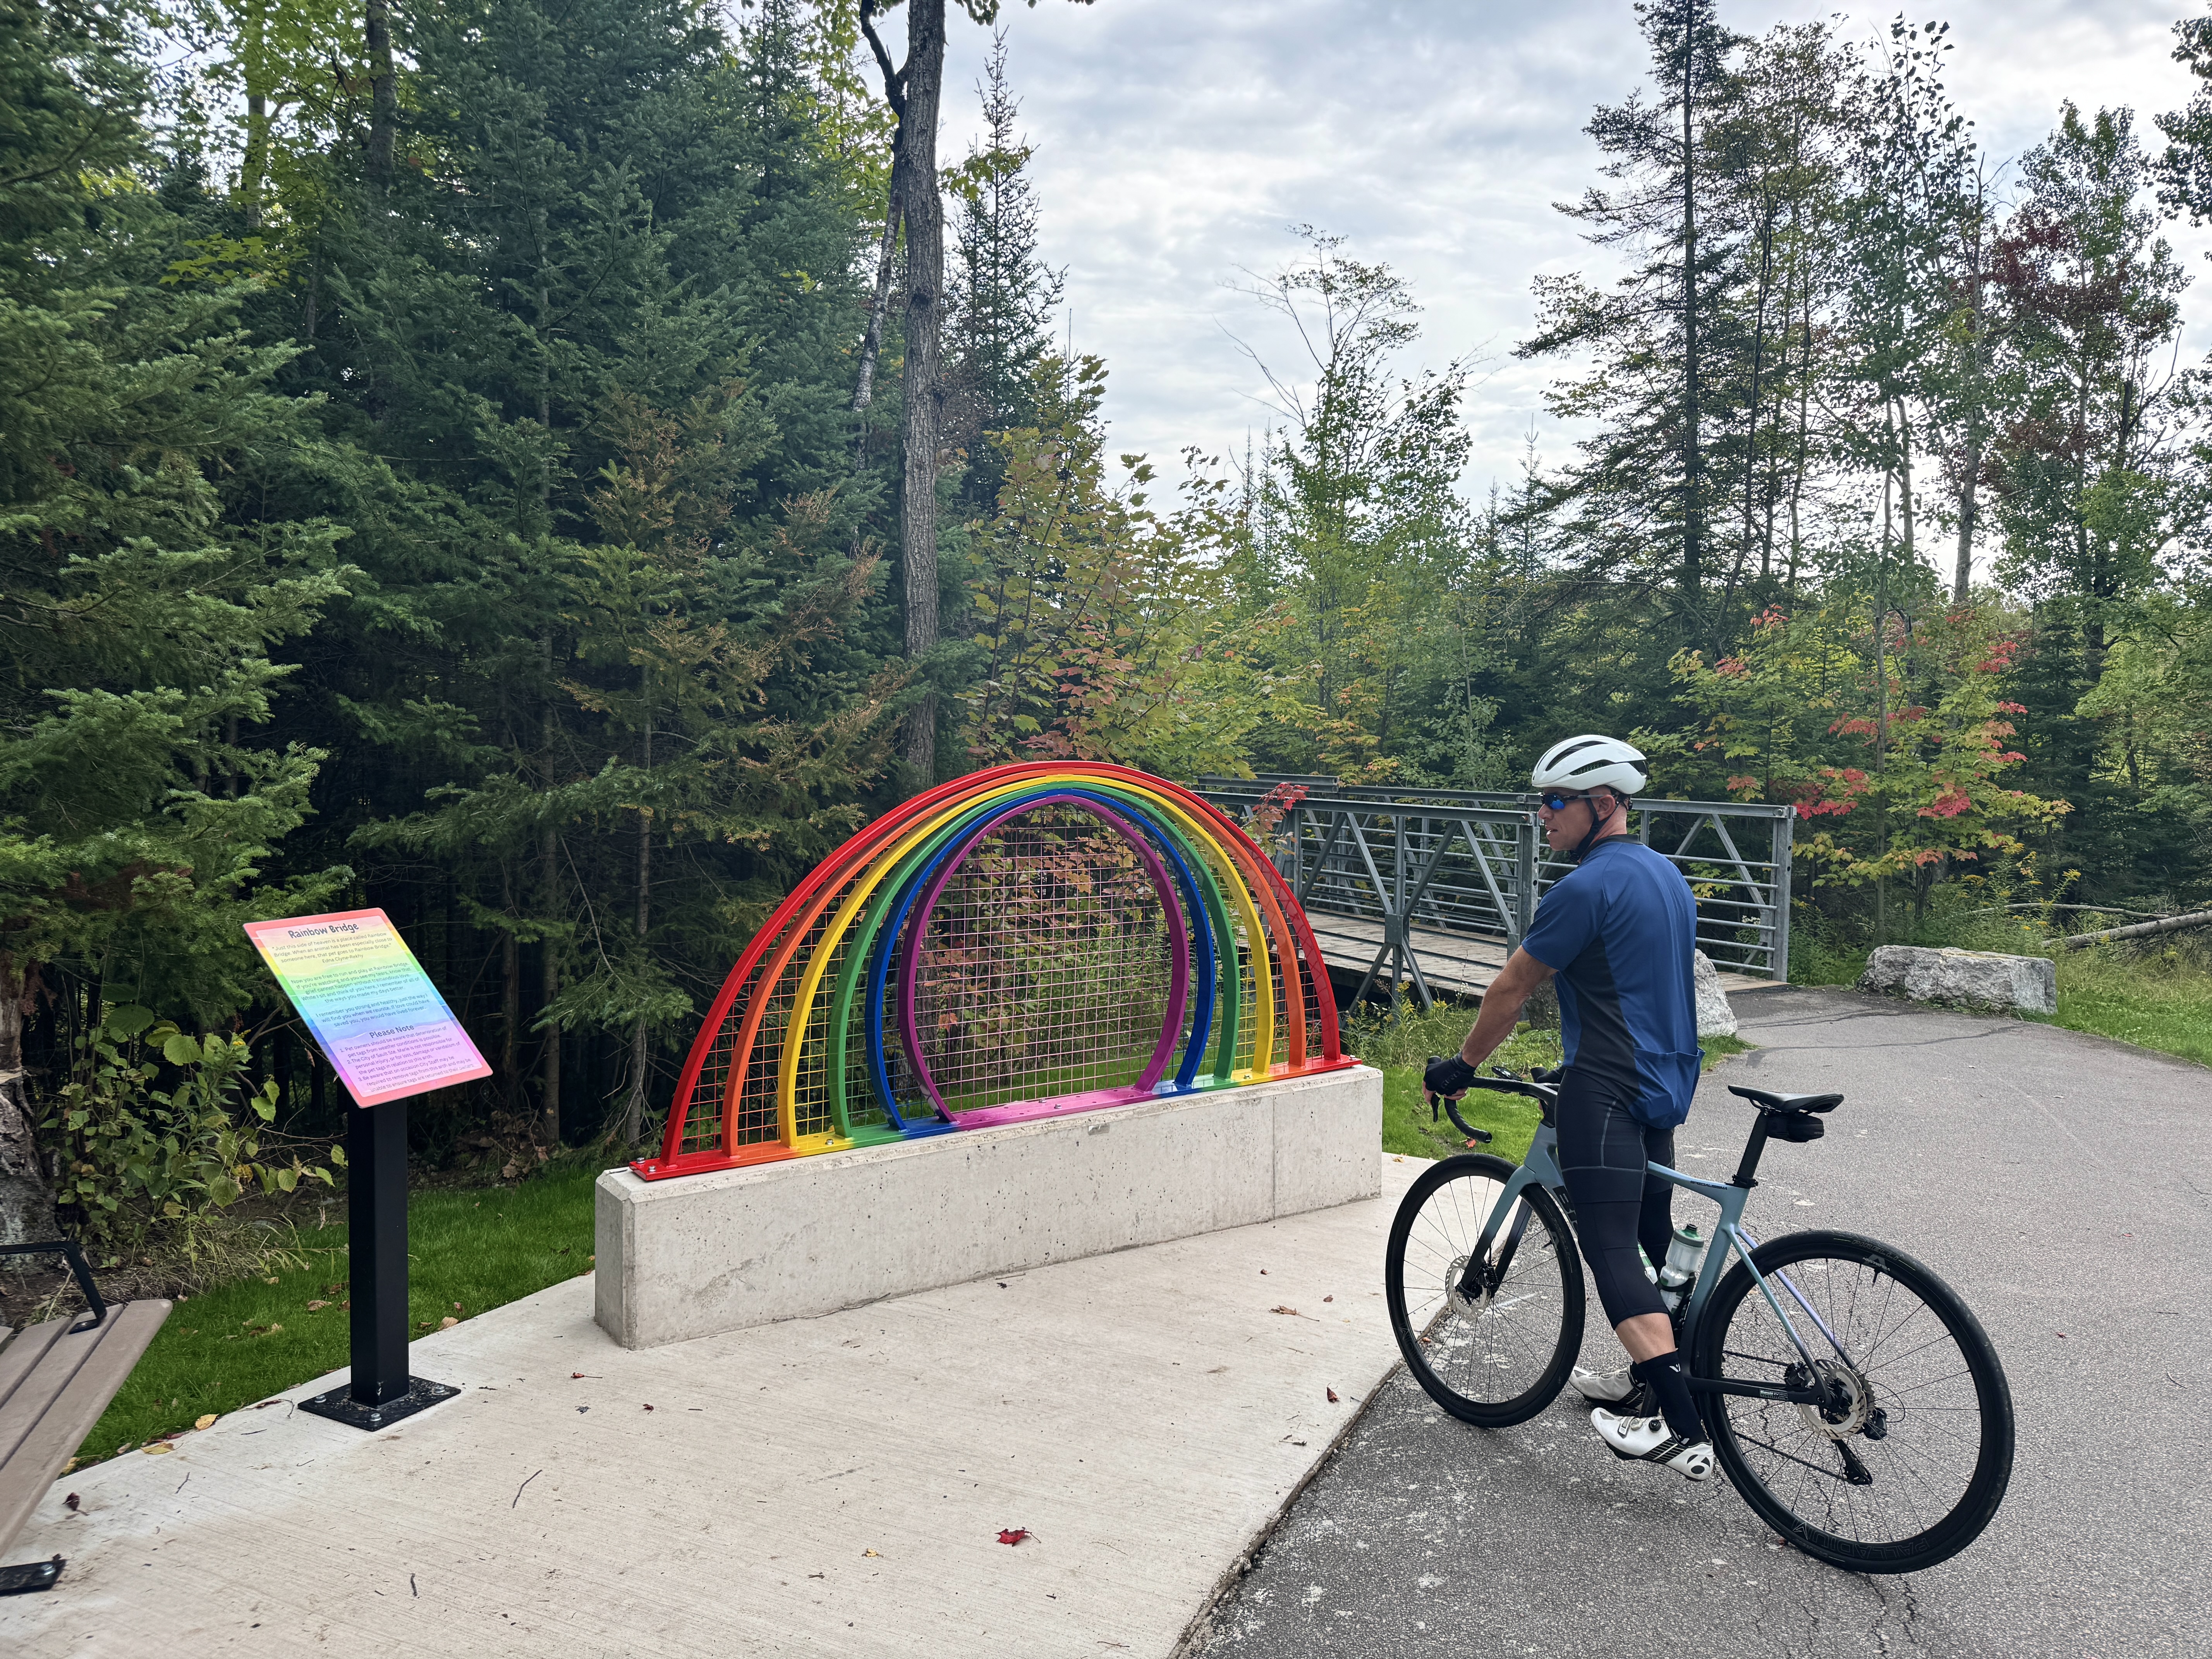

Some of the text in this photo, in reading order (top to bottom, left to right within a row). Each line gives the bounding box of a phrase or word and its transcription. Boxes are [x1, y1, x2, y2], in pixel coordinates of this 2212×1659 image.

[288, 923, 359, 938] Rainbow Bridge
[369, 1029, 395, 1038] Please
[415, 1028, 442, 1036] deterioration
[355, 1061, 376, 1070] personal
[367, 1078, 386, 1086] required
[1851, 1240, 1899, 1261] PIRELLI
[1791, 1518, 1930, 1559] PALLADIUM
